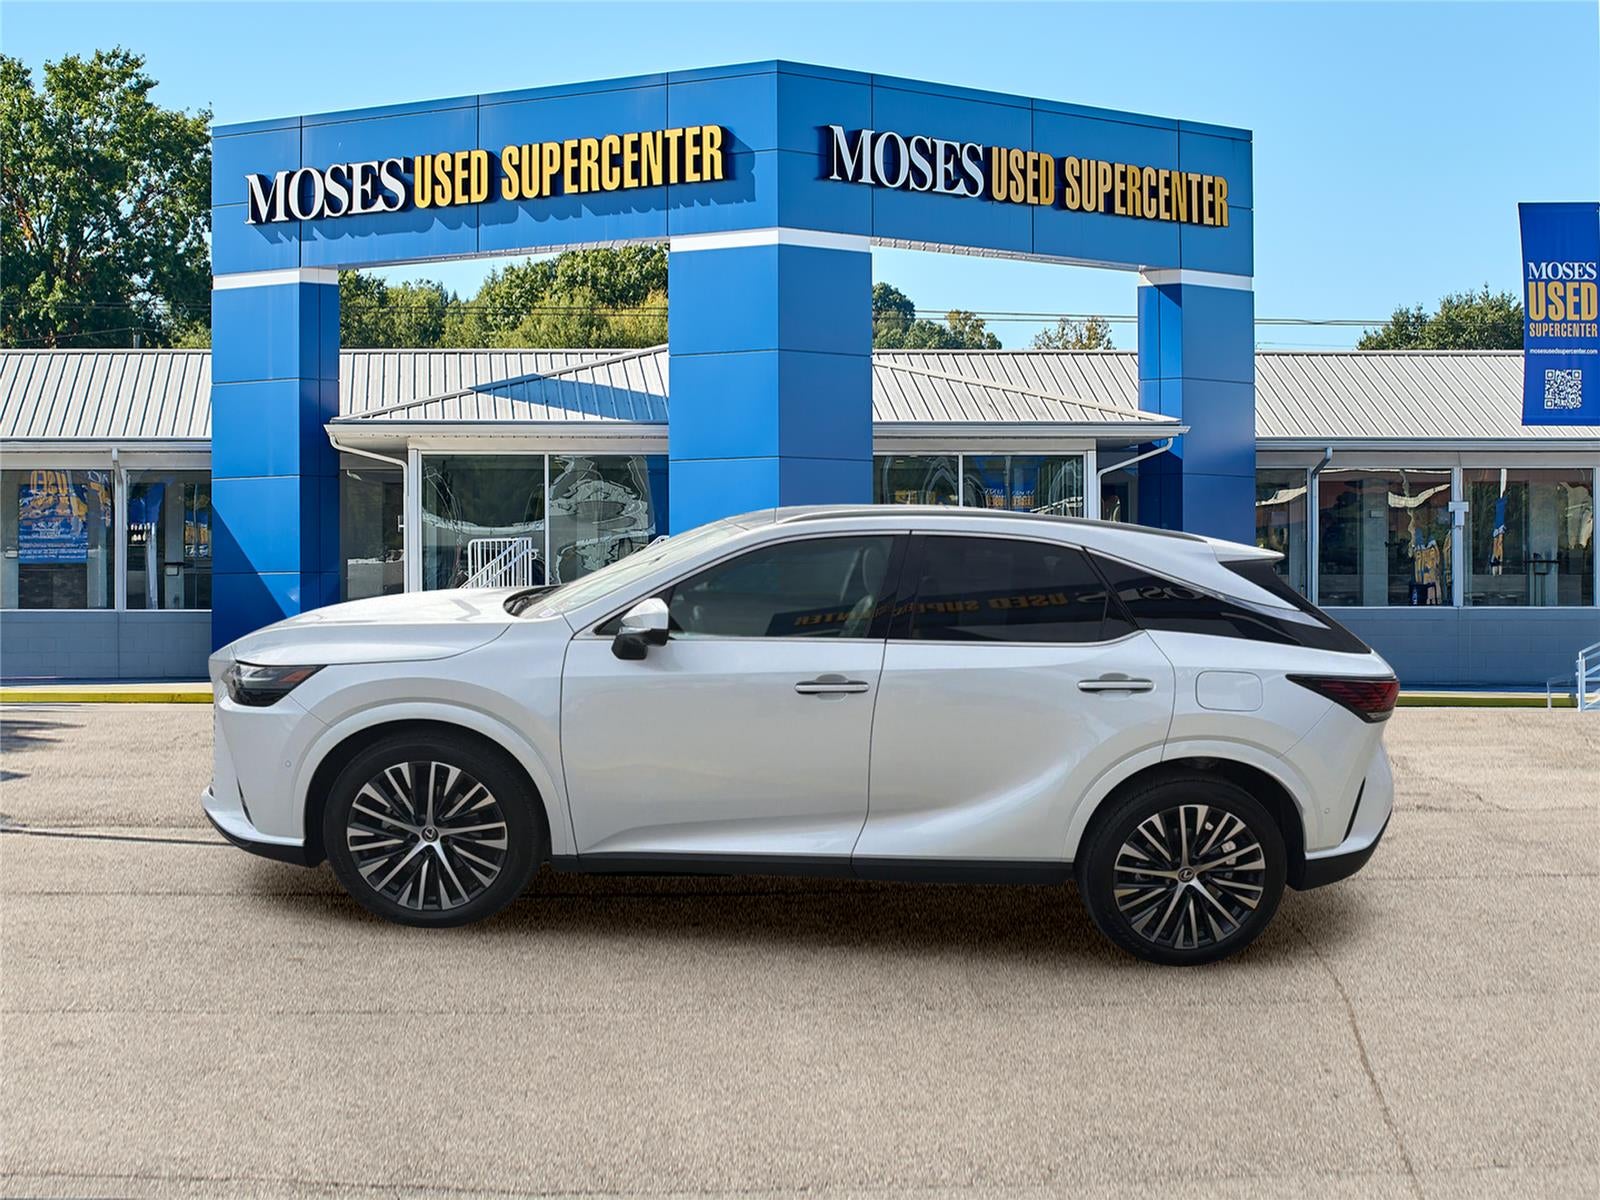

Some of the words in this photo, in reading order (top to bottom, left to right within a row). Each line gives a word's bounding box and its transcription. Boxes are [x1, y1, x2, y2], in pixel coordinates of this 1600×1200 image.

[245, 158, 406, 225] MOSES
[413, 149, 488, 209] USED
[500, 124, 724, 201] SUPERCENTER
[829, 125, 984, 198] MOSES
[991, 146, 1055, 206] USED
[1065, 156, 1229, 227] SUPERCENTER
[1528, 261, 1597, 280] MOSES
[1528, 281, 1598, 321] USED
[1529, 323, 1598, 338] SUPERCENTER
